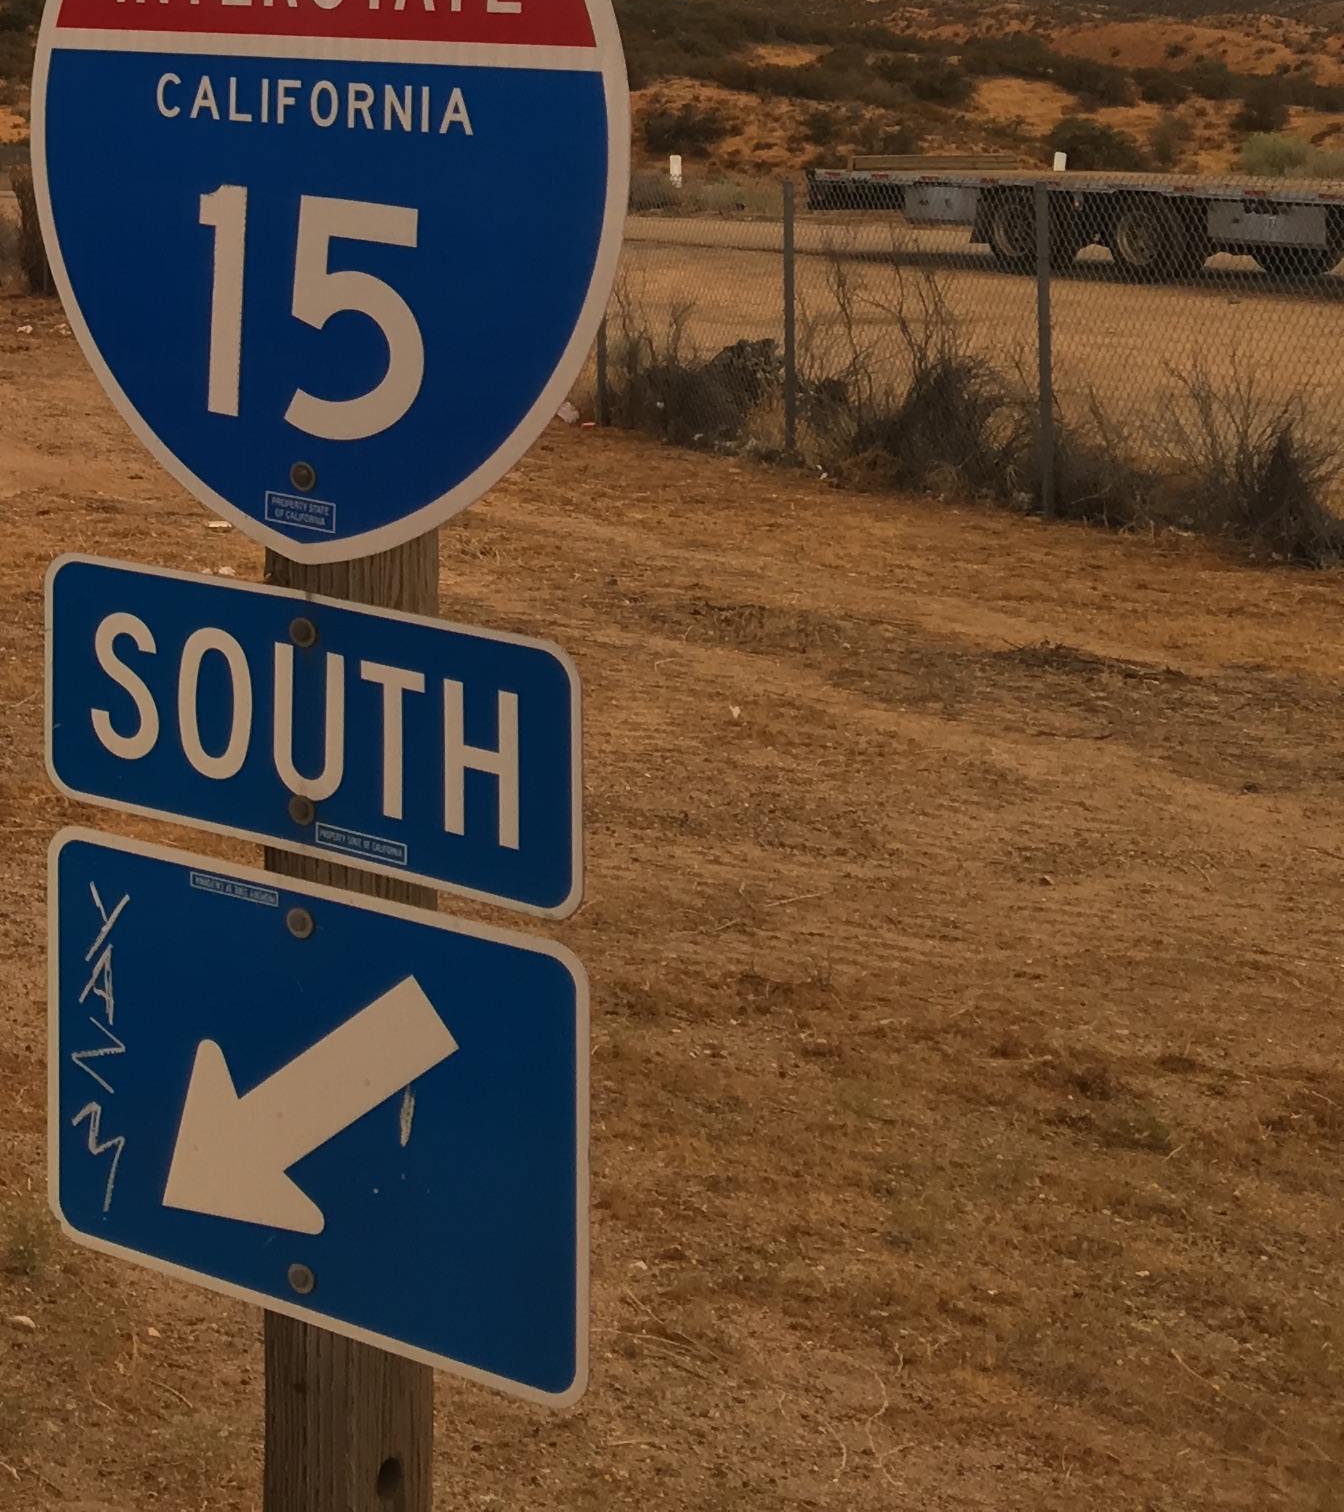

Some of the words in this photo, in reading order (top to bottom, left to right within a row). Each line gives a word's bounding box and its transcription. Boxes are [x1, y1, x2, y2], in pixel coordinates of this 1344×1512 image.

[156, 73, 473, 135] CALIFORNIA
[199, 183, 425, 440] 15
[272, 496, 309, 511] PROPERTY
[309, 504, 330, 516] STATE
[275, 508, 284, 517] OF
[285, 510, 326, 526] CALIFORNIA
[91, 612, 520, 850] SOUTH
[319, 828, 346, 842] PROPERTY
[372, 841, 403, 857] CALIFORNIA
